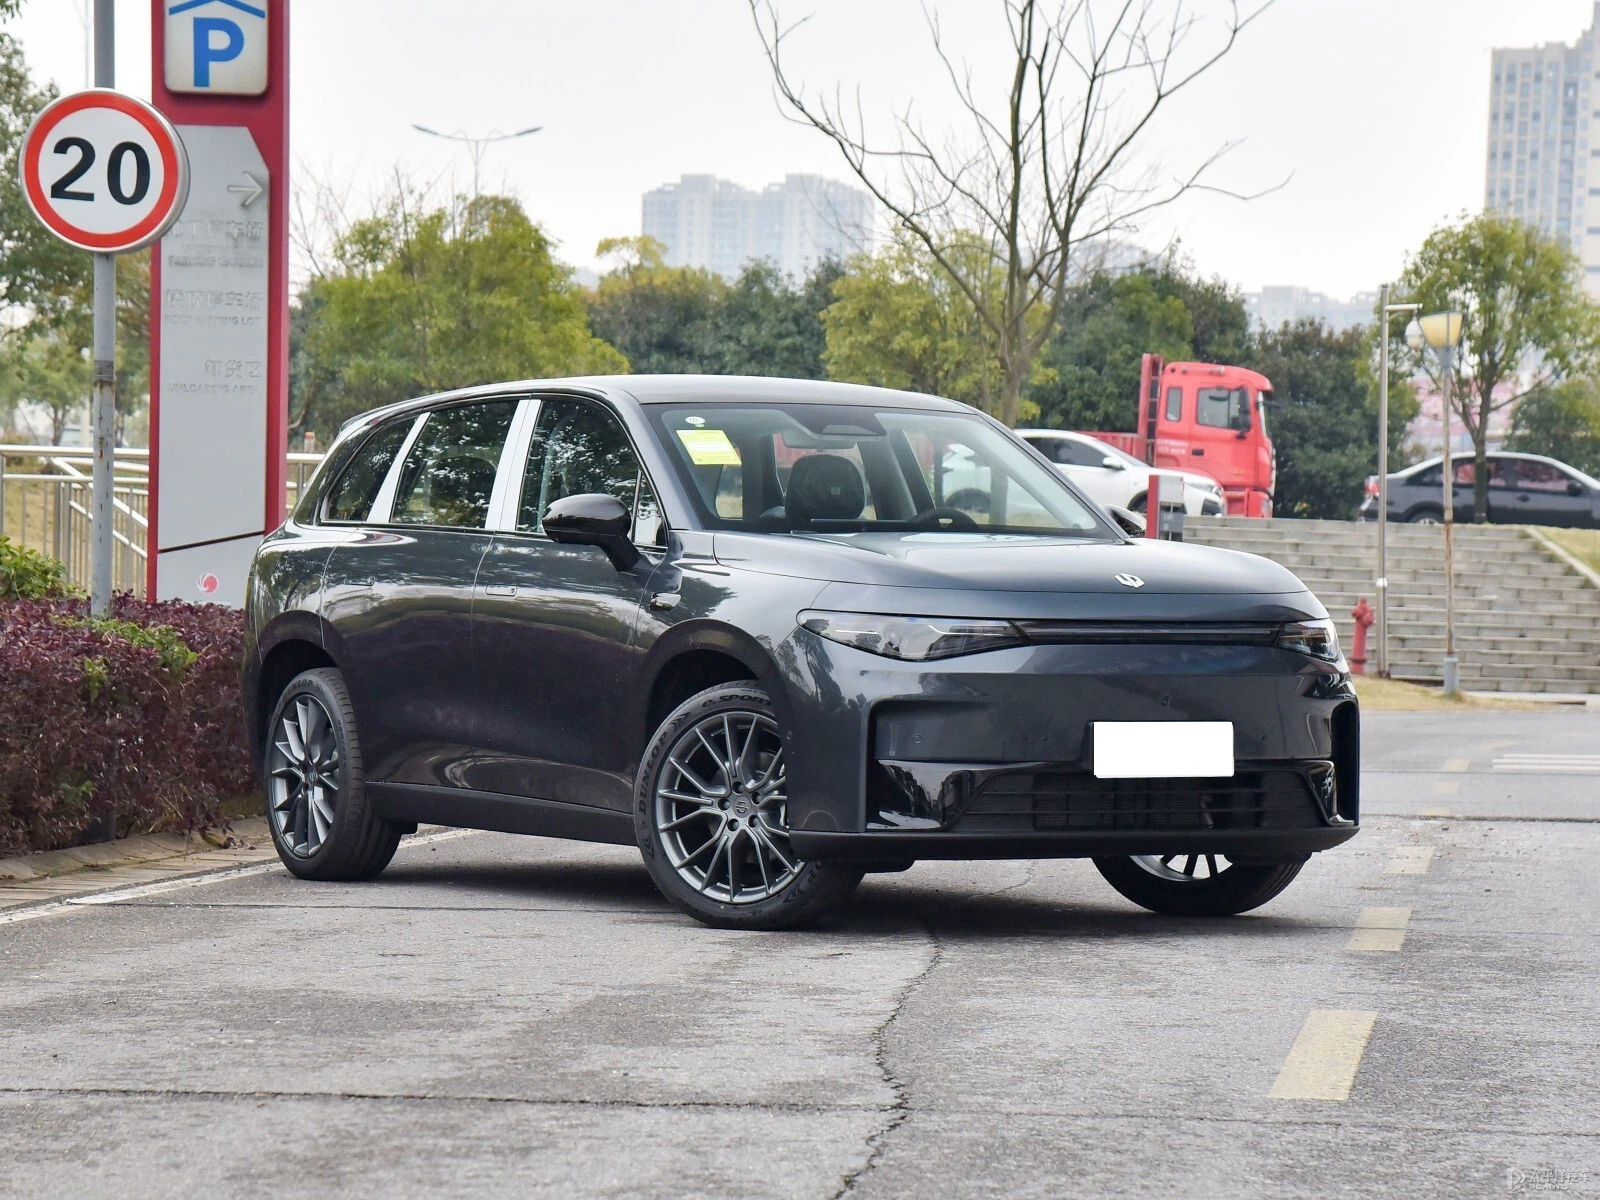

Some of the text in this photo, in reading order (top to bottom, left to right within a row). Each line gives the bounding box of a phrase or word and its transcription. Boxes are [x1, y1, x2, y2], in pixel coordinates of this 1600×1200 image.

[193, 17, 245, 88] P
[50, 136, 151, 206] 20
[638, 732, 668, 815] DUNLOP
